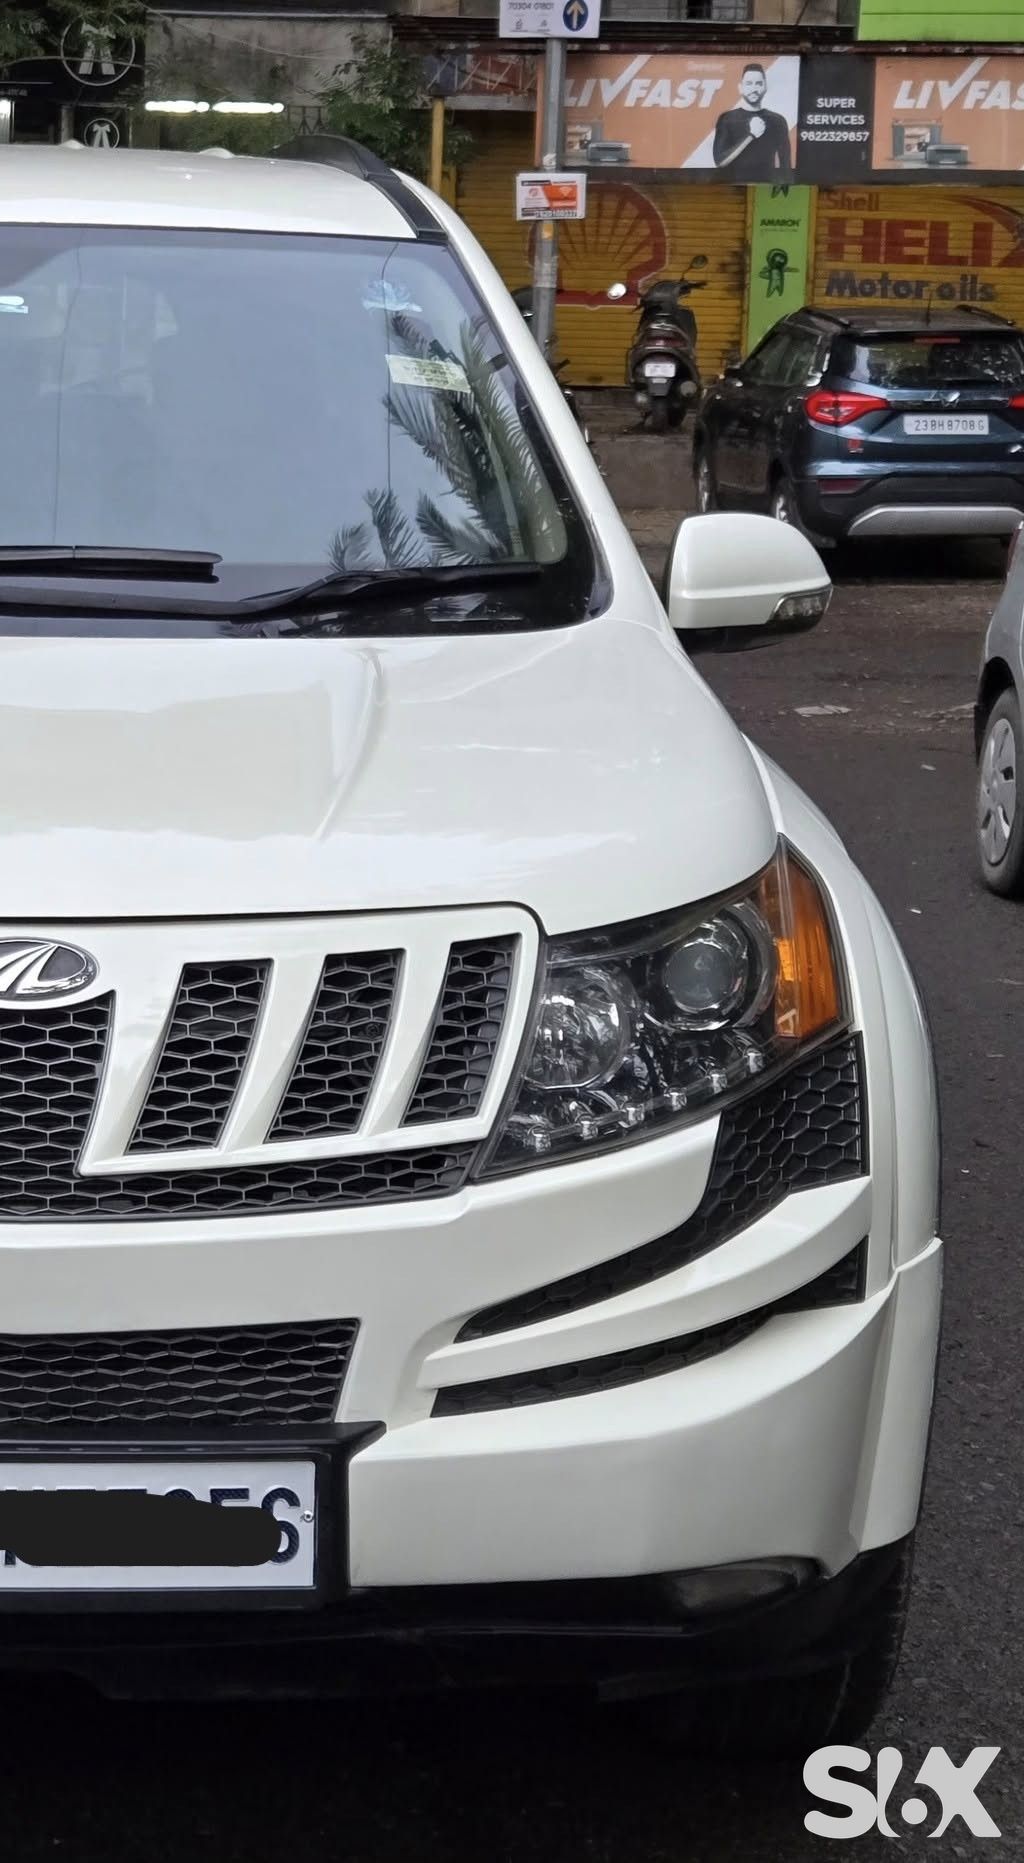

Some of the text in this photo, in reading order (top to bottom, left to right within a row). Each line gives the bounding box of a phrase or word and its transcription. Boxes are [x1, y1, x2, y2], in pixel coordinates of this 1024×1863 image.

[563, 55, 724, 108] LIVFAST
[816, 98, 856, 108] SUPER
[806, 115, 865, 125] SERVICES
[800, 131, 870, 142] 9822329857
[824, 191, 879, 211] Shell
[760, 218, 799, 227] AMARON
[826, 269, 996, 301] Motor oils
